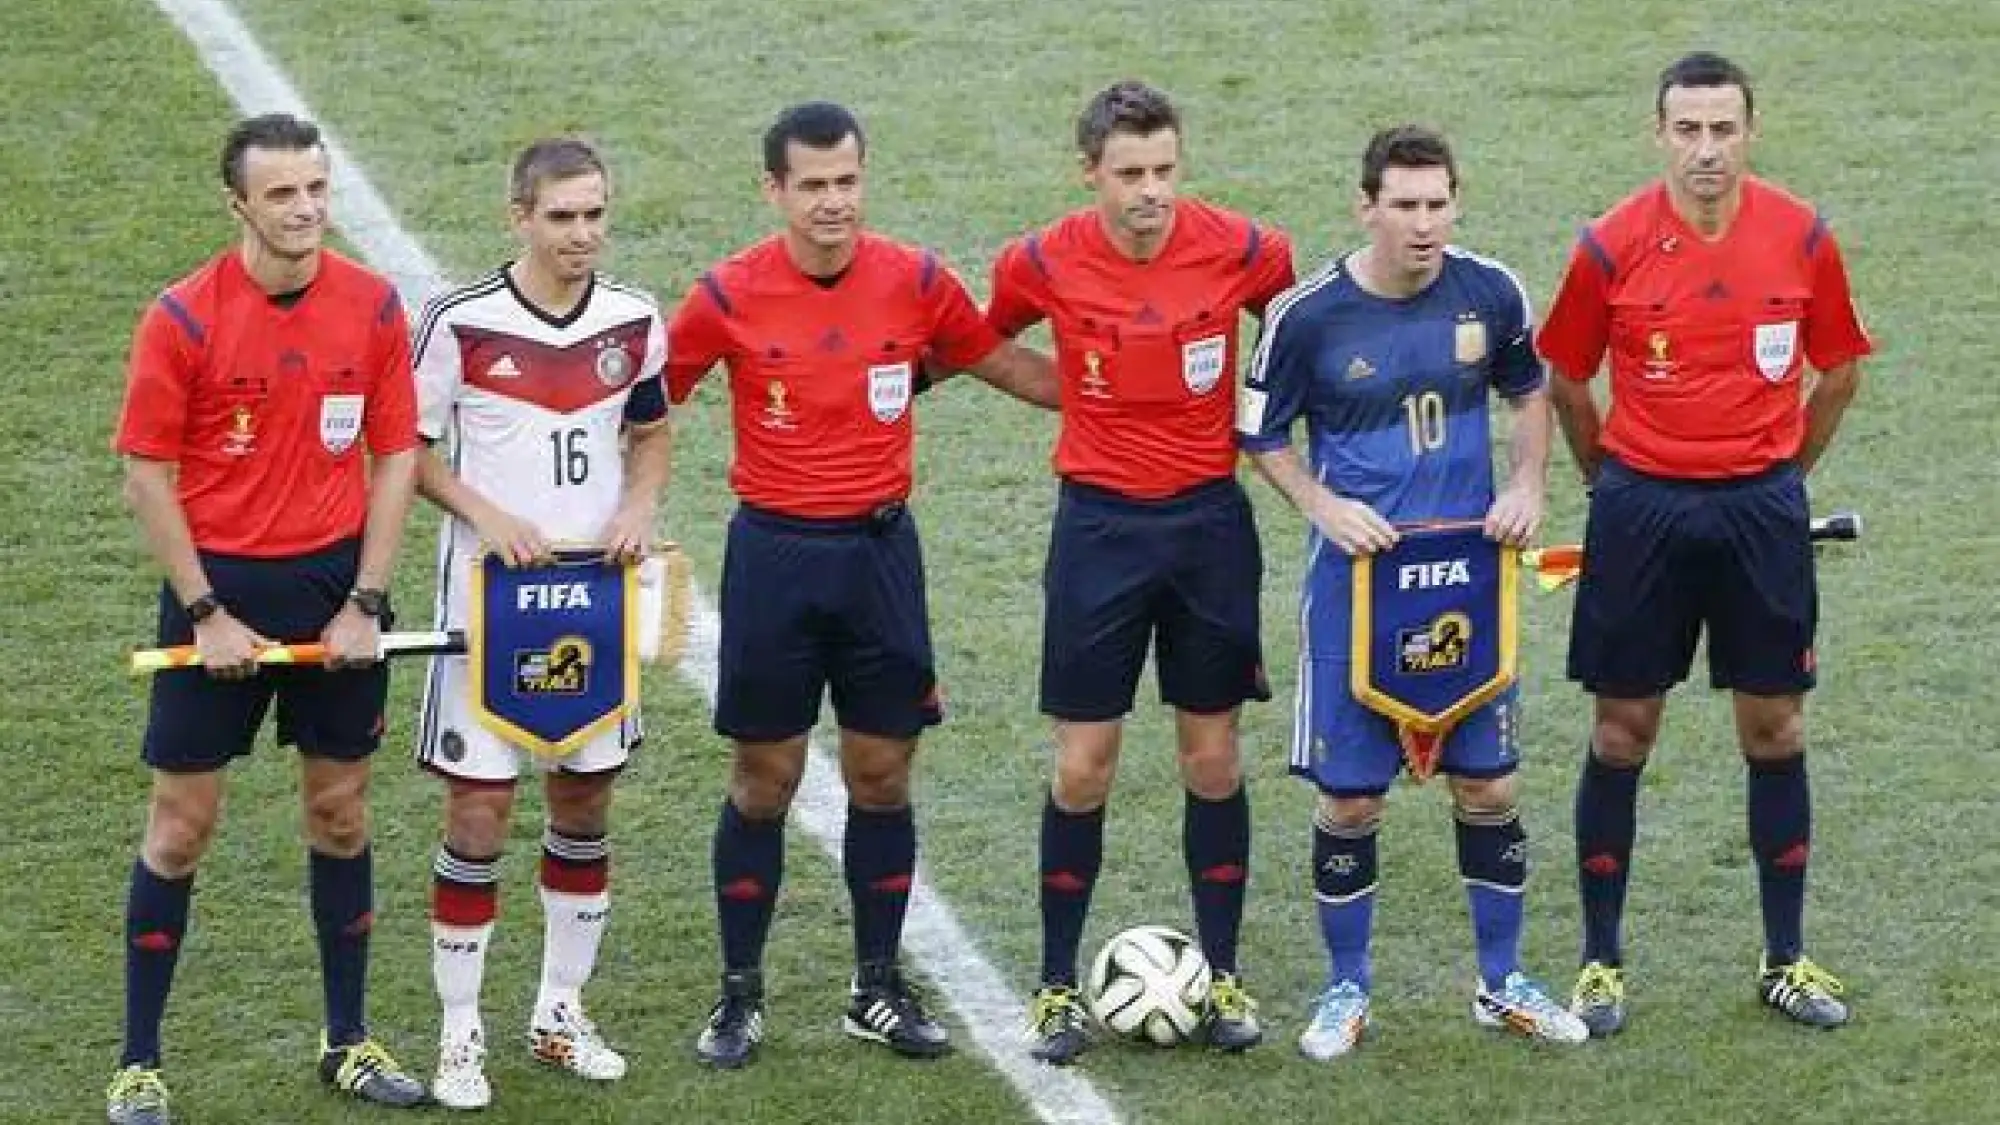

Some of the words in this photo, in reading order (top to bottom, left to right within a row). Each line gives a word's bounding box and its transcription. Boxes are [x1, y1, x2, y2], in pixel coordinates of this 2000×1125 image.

[1401, 391, 1446, 456] 10
[550, 427, 588, 487] 16
[516, 582, 592, 609] FIFA
[1398, 558, 1470, 589] FIFA
